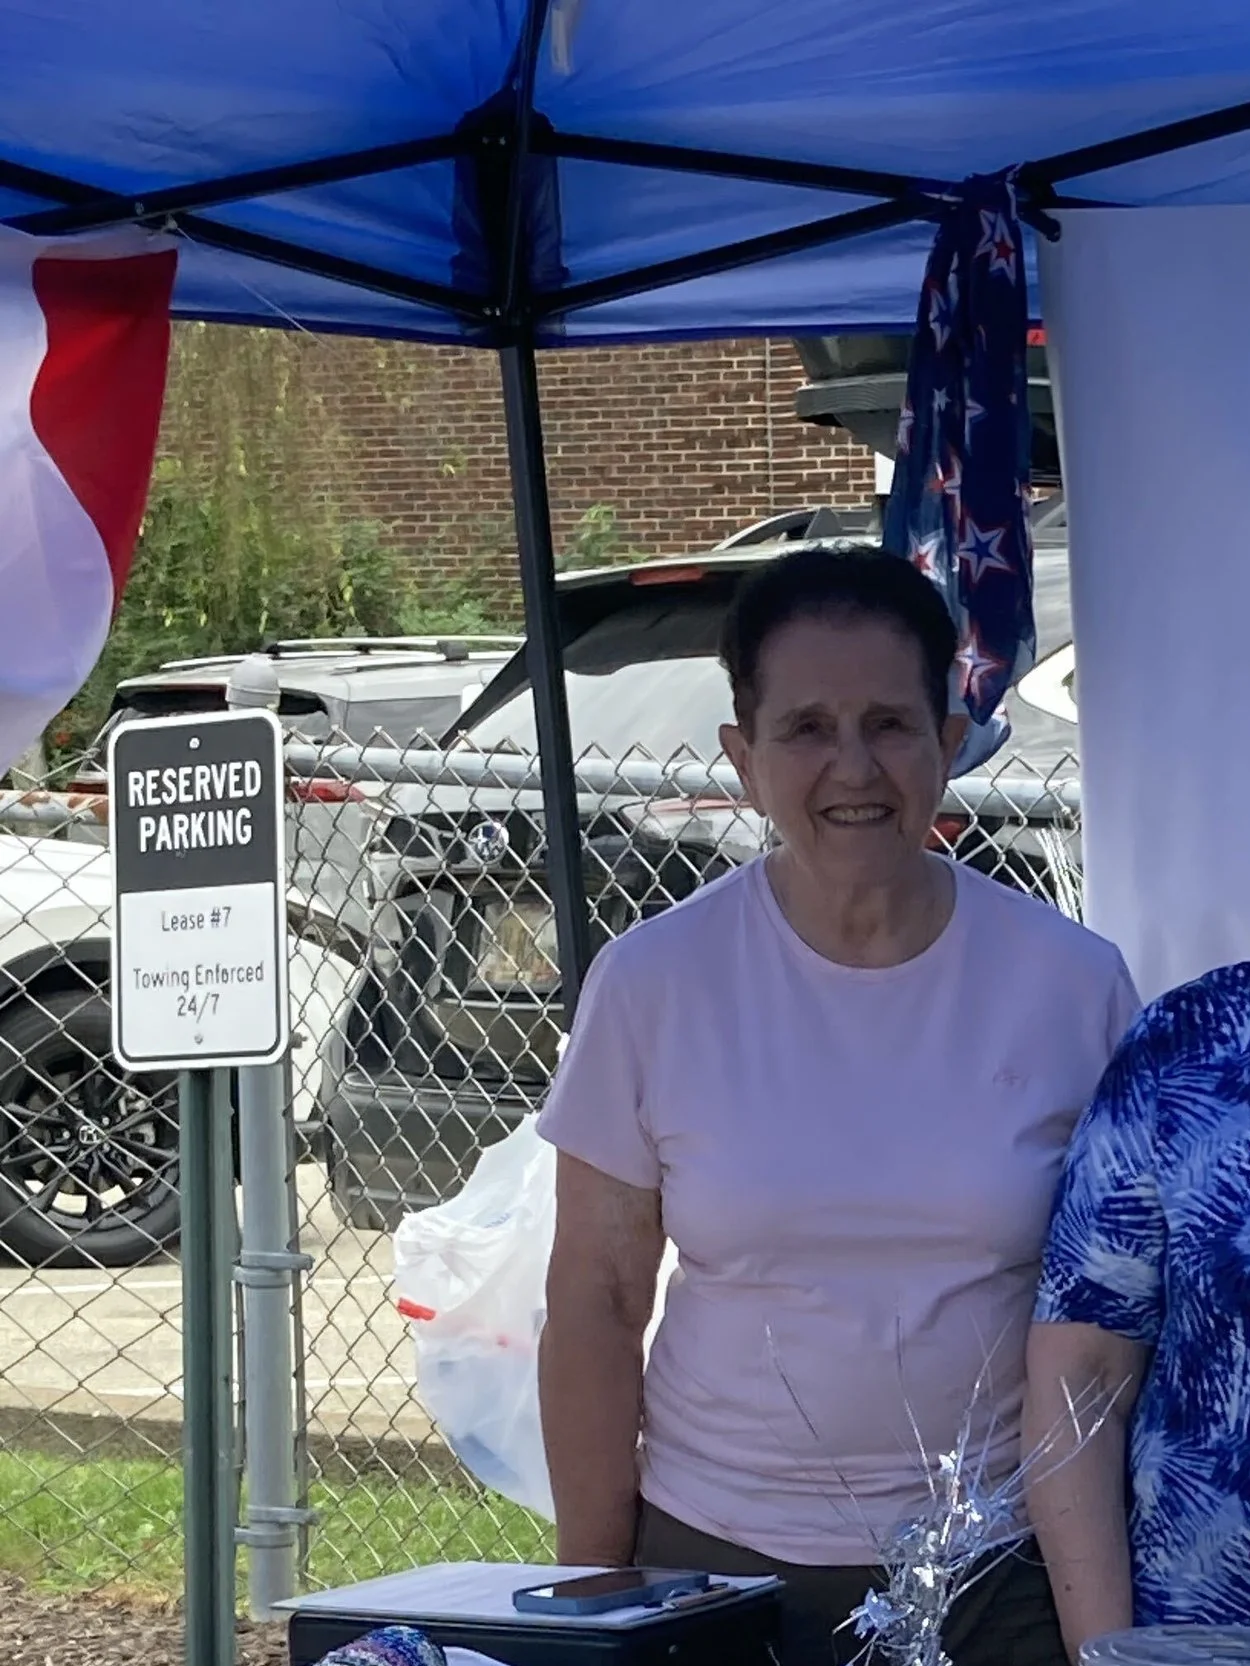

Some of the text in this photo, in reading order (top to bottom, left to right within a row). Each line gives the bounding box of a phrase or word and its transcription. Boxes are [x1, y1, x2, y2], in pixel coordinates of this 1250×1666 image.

[128, 760, 262, 807] RESERVED
[139, 807, 252, 852] PARKING
[161, 906, 232, 931] Lease #7
[133, 960, 264, 992] Towing Enforced
[177, 992, 220, 1024] 24/7
